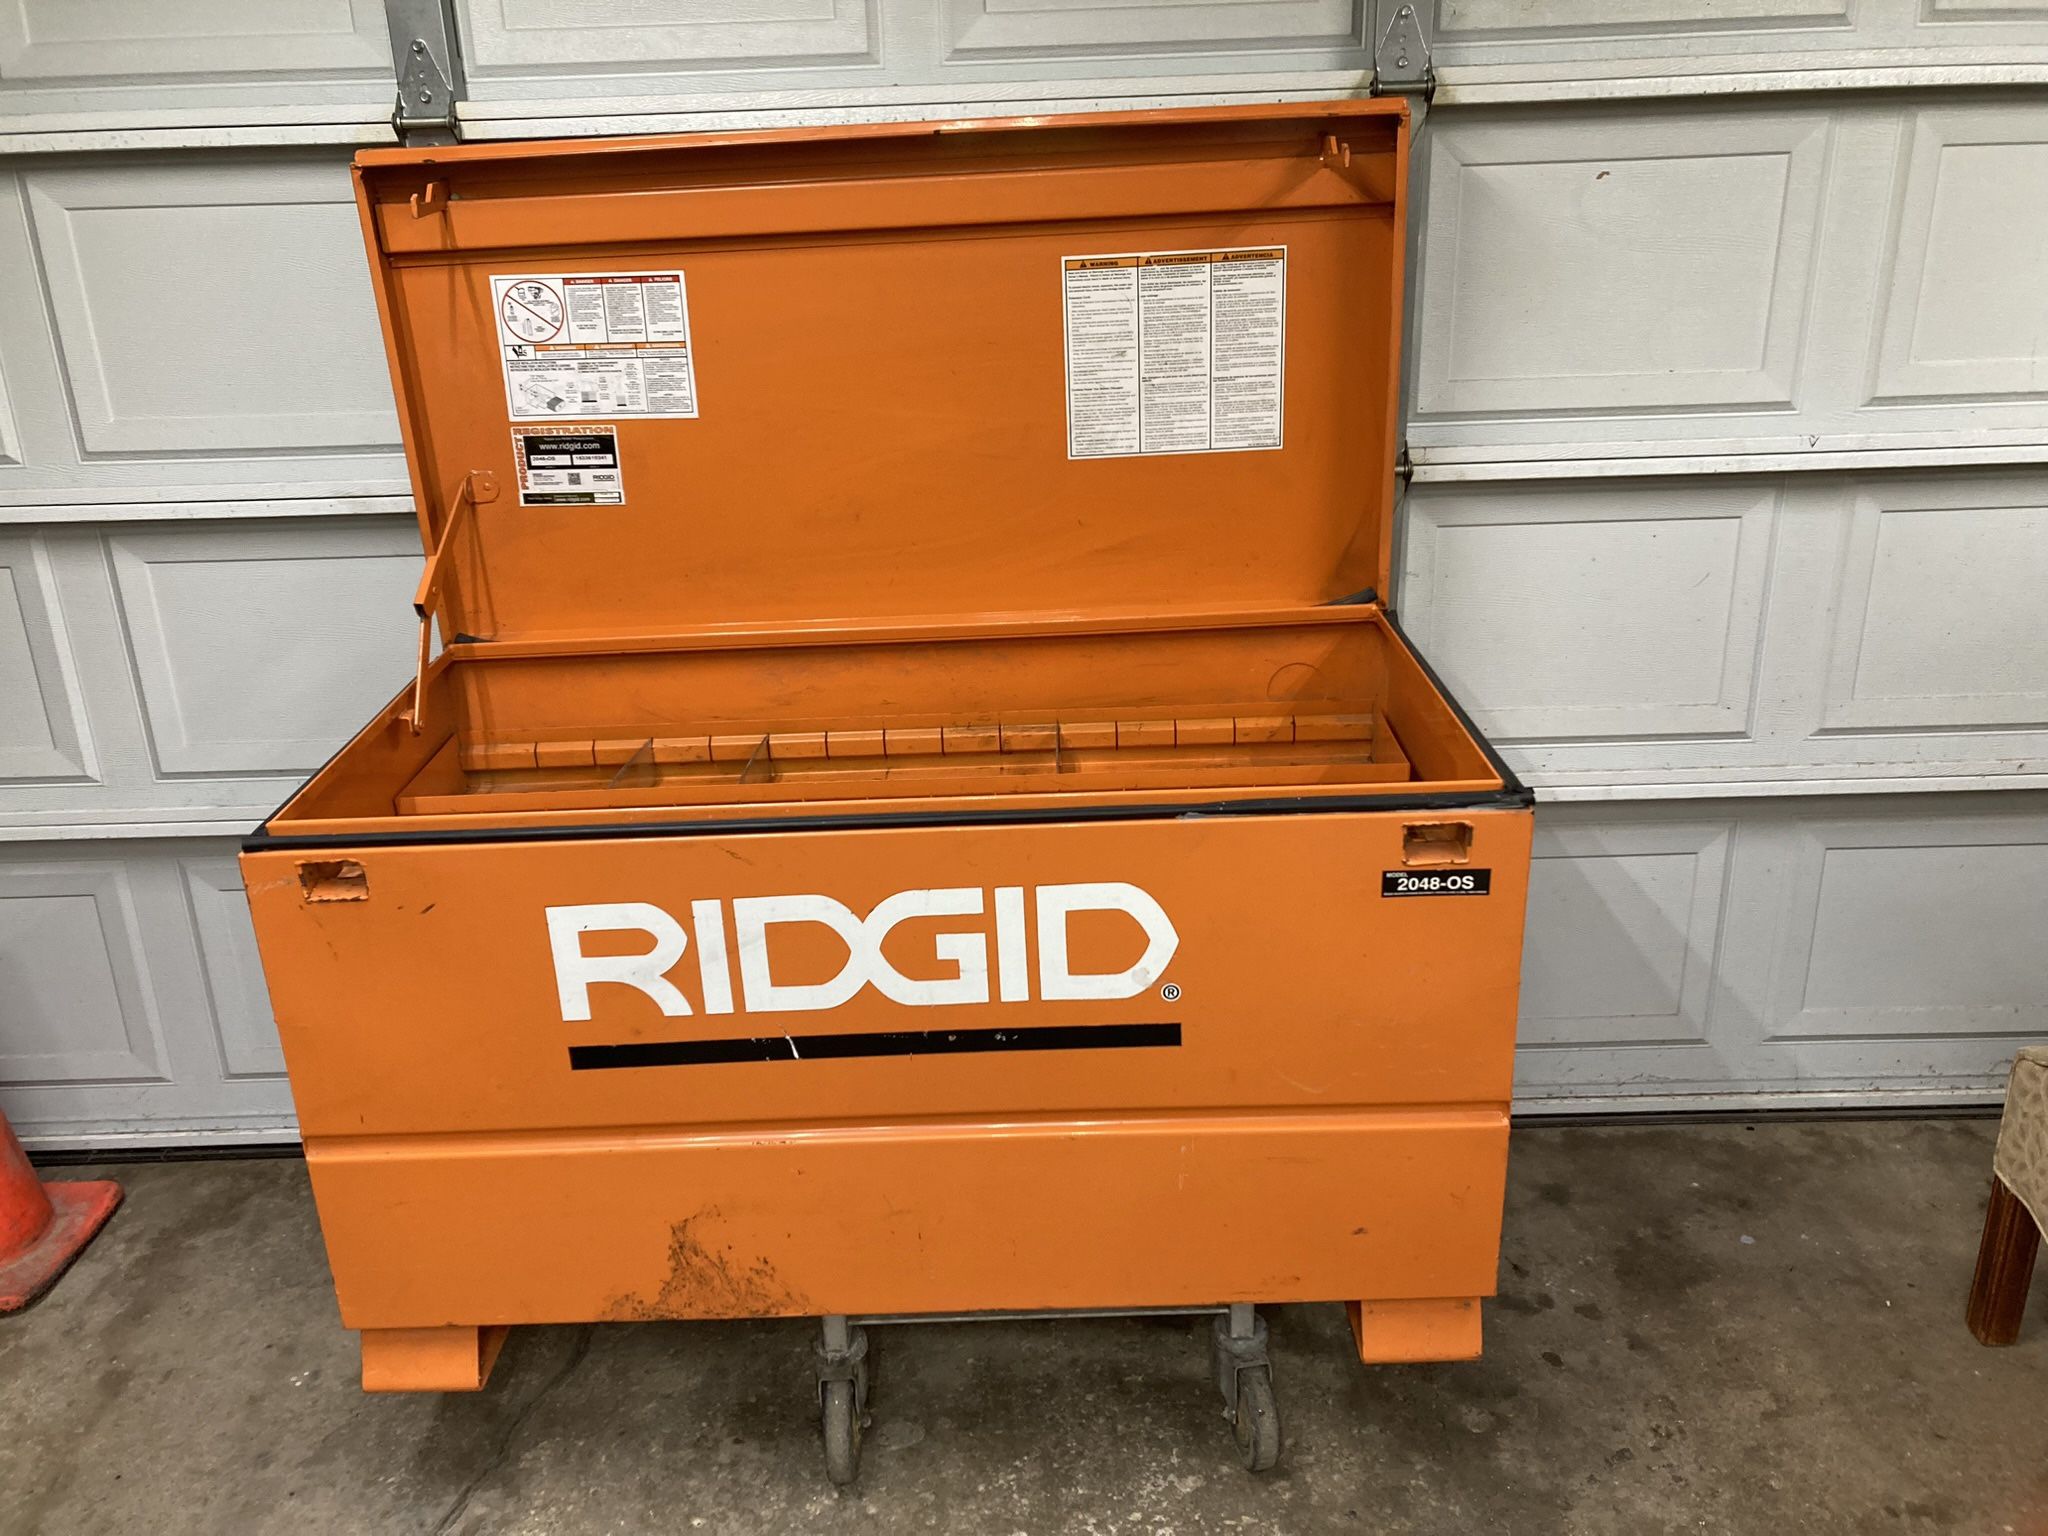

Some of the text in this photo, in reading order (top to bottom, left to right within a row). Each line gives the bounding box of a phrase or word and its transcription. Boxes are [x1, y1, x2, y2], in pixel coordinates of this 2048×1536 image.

[512, 426, 614, 435] REGISTRATION
[539, 442, 600, 451] www.ridgid.com
[514, 437, 529, 490] PRODUCT
[1397, 875, 1474, 890] 2048-OS
[545, 882, 1180, 1021] RIDGID
